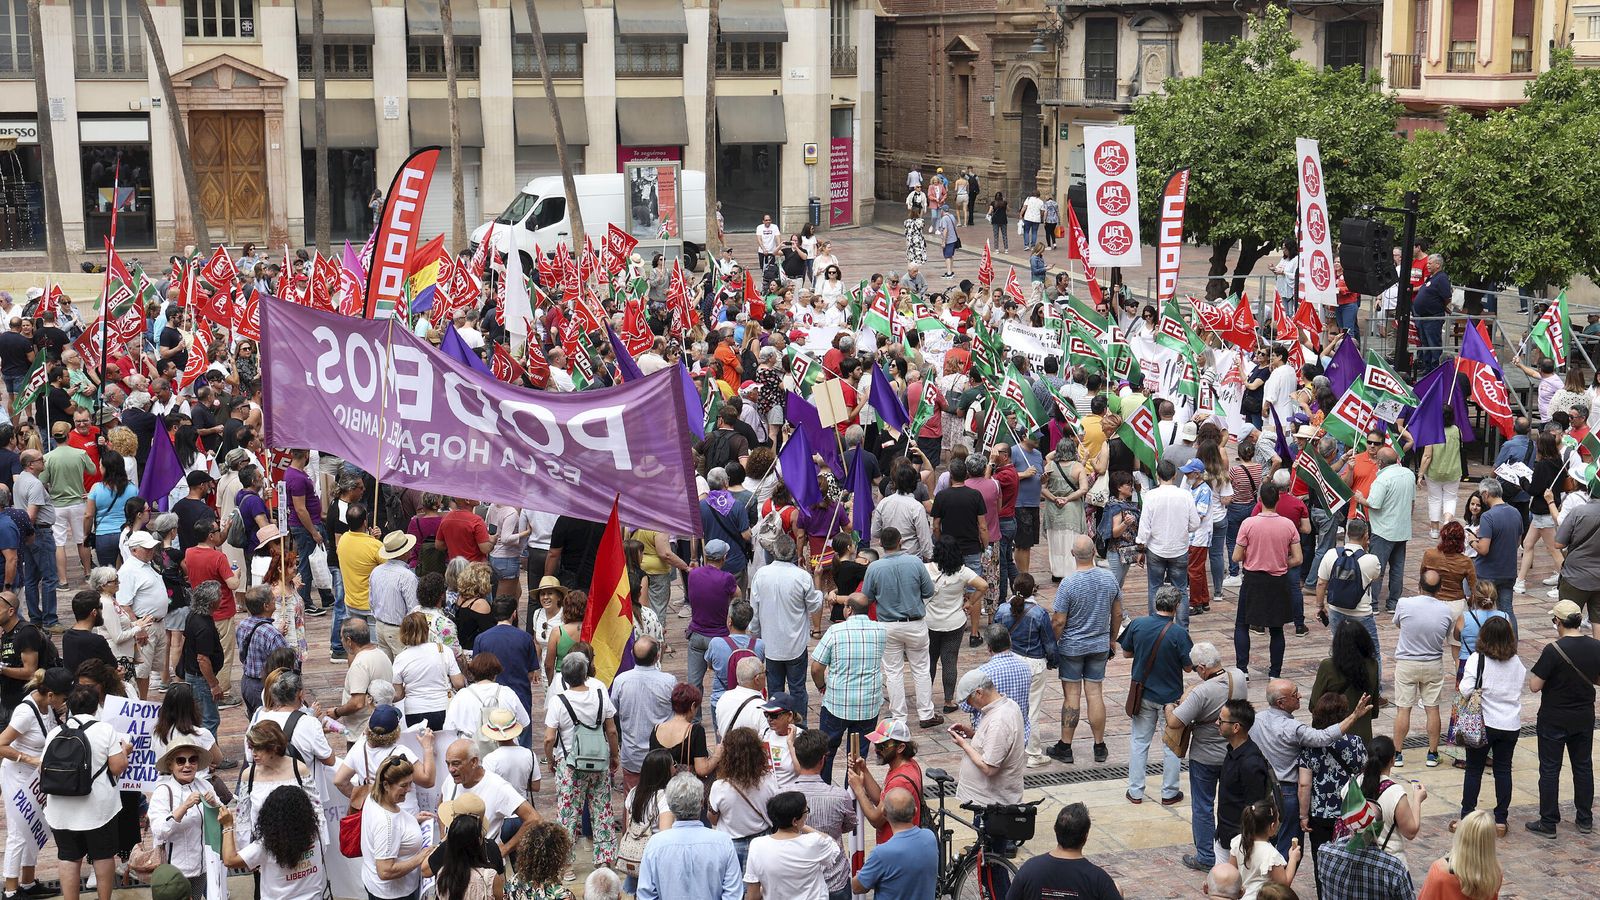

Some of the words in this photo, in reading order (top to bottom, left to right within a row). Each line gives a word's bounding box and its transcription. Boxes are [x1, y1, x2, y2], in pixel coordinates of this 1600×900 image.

[1101, 146, 1121, 158] UGT
[831, 181, 842, 191] ODAS
[1103, 186, 1123, 198] UGT
[378, 167, 425, 296] CCOO
[1105, 225, 1126, 238] UGT
[1160, 195, 1185, 295] CCOO
[127, 720, 149, 735] AL
[13, 789, 35, 824] PARA
[30, 819, 48, 850] IRAN
